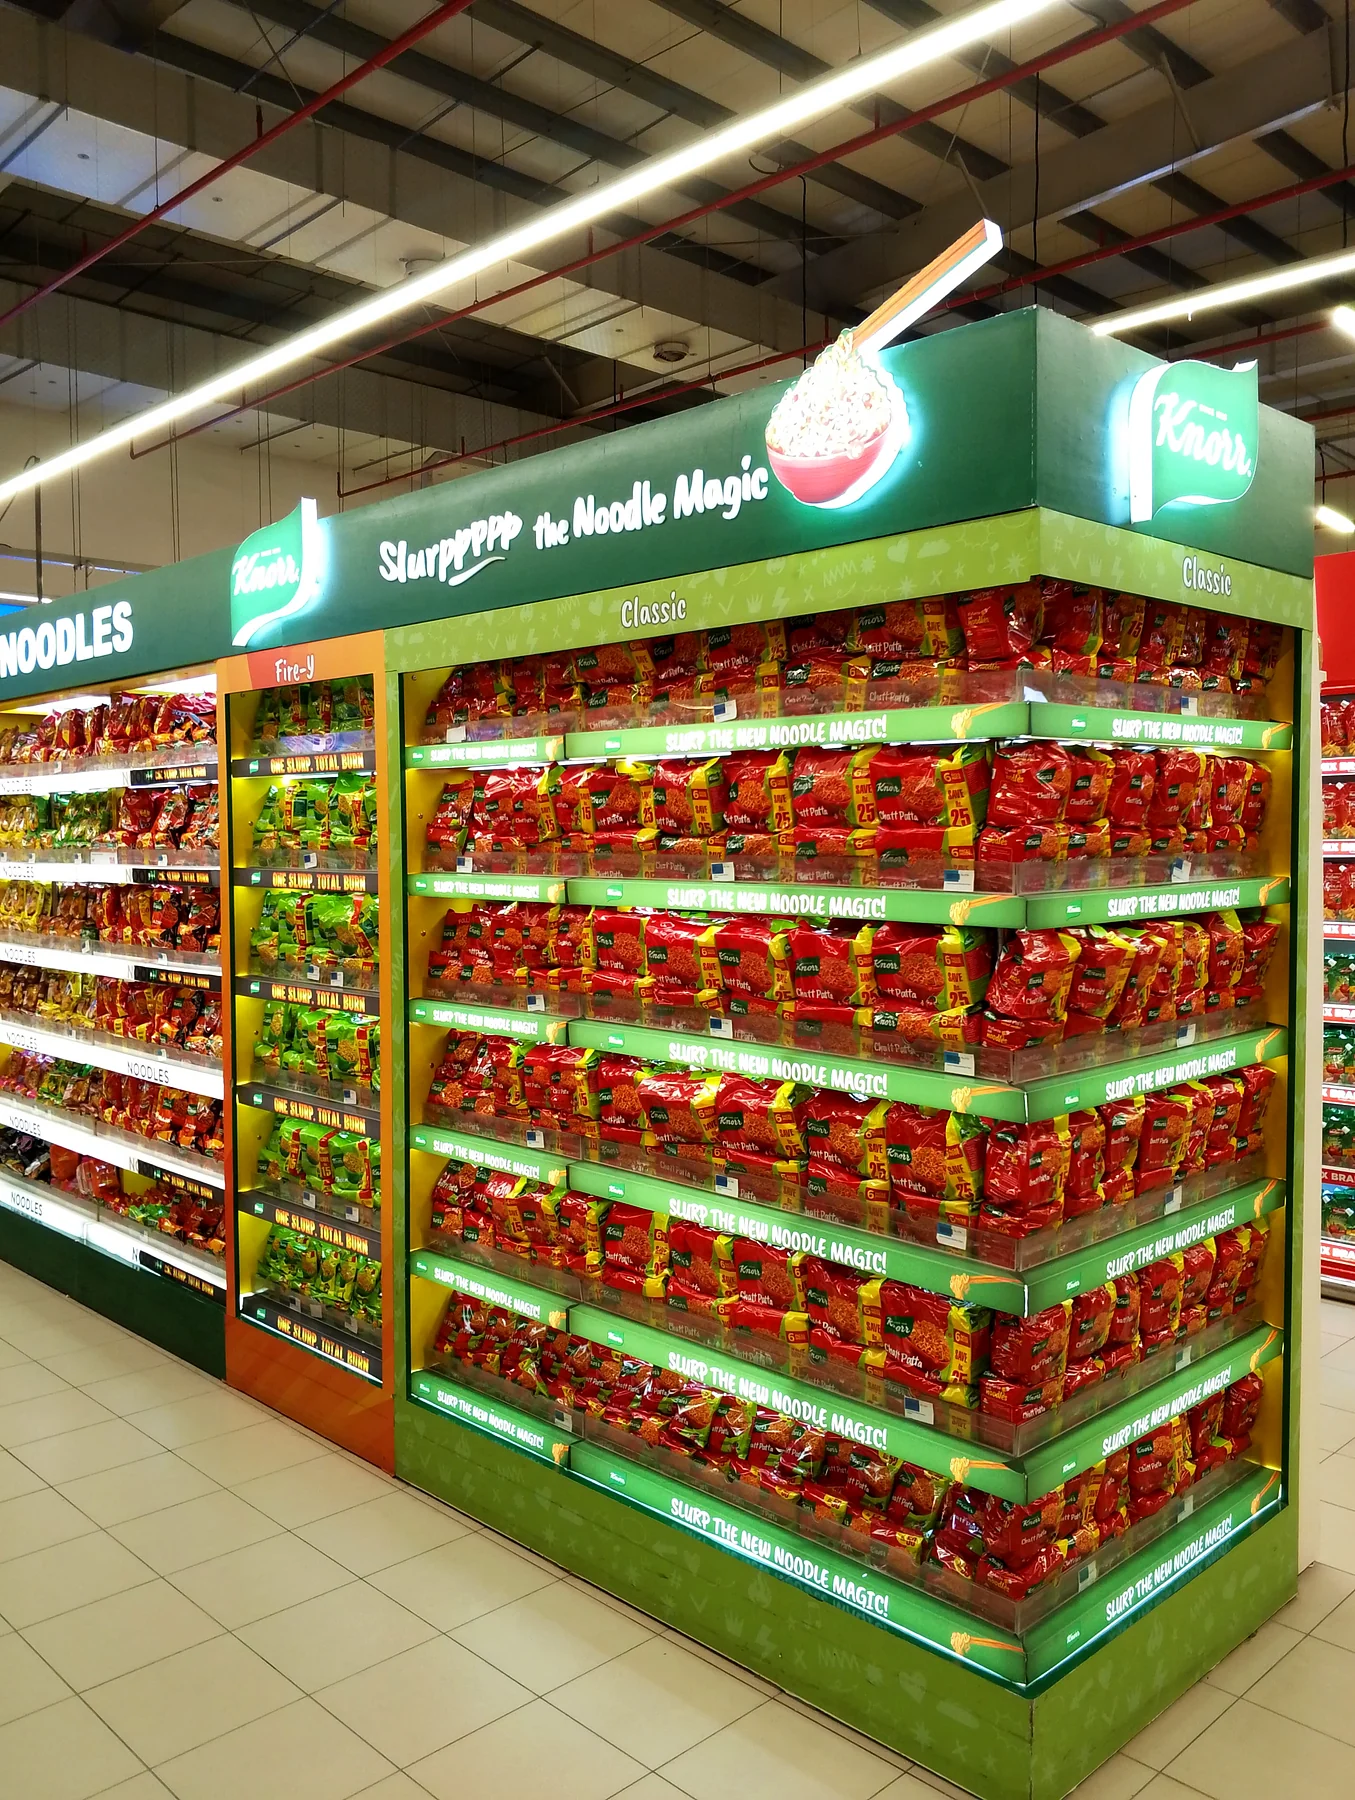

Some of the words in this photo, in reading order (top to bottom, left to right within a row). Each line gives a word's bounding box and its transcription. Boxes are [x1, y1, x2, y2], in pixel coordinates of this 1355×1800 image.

[1154, 392, 1252, 478] Knorr
[379, 511, 523, 583] Slurppppp
[533, 512, 569, 549] the
[573, 481, 667, 538] Noodle
[673, 454, 769, 520] Magic
[232, 553, 300, 596] Knorr
[1183, 555, 1232, 596] Classic
[621, 591, 687, 628] Classic
[858, 614, 886, 627] Knorr
[0, 601, 134, 679] NOODLES
[275, 654, 316, 682] Fire-y
[665, 730, 706, 753] SLURP
[708, 729, 734, 750] THE
[736, 727, 767, 749] NEW
[769, 723, 826, 746] NOODLE
[828, 714, 886, 743] MAGIC!
[1112, 719, 1142, 740] SLURP
[1142, 720, 1161, 739] THE
[1162, 722, 1181, 740] NEW
[1182, 724, 1214, 742] NOODLE
[269, 758, 286, 774] ONE
[286, 755, 314, 773] SLURP.
[314, 754, 339, 772] TOTAL
[341, 752, 364, 769] BURN
[855, 783, 872, 793] SAVE
[948, 789, 965, 800] SAVE
[857, 803, 875, 822] 25
[878, 810, 899, 821] Chatt
[900, 811, 918, 821] Patta
[950, 807, 971, 826] 25
[273, 872, 288, 888] ONE
[288, 873, 314, 889] SLURP.
[317, 874, 341, 890] TOTAL
[343, 873, 365, 892] BURN
[667, 888, 706, 908] SLURP
[708, 889, 734, 910] THE
[736, 891, 767, 911] NEW
[770, 893, 825, 915] NOODLE
[829, 896, 885, 918] MAGIC!
[1108, 897, 1139, 916] SLURP
[1139, 896, 1157, 912] THE
[1158, 894, 1177, 911] NEW
[1179, 891, 1210, 910] NOODLE
[1212, 887, 1239, 907] MAGIC!
[719, 951, 740, 963] Knorr
[796, 961, 819, 973] Knorr
[875, 958, 899, 970] Knorr
[272, 984, 286, 1000] ONE
[288, 987, 314, 1005] SLURP.
[316, 989, 340, 1009] TOTAL
[343, 993, 367, 1013] BURN
[796, 988, 815, 998] Chatt
[816, 989, 834, 999] Patta
[434, 1010, 454, 1022] SLURP
[454, 1012, 467, 1025] THE
[468, 1014, 483, 1026] NEW
[484, 1016, 511, 1031] NOODLE
[127, 1061, 170, 1084] NOODLES
[669, 1043, 708, 1067] SLURP
[710, 1048, 736, 1070] THE
[738, 1053, 768, 1074] NEW
[772, 1058, 827, 1085] NOODLE
[831, 1069, 887, 1095] MAGIC!
[1106, 1076, 1135, 1100] SLURP
[1136, 1072, 1154, 1091] THE
[1156, 1067, 1174, 1086] NEW
[1176, 1057, 1206, 1081] NOODLE
[1208, 1048, 1235, 1072] MAGIC!
[9, 1116, 41, 1137] NOODLES
[274, 1098, 288, 1114] ONE
[290, 1102, 317, 1121] SLURP.
[317, 1108, 341, 1128] TOTAL
[344, 1114, 367, 1135] BURN
[719, 1115, 742, 1126] Knorr
[434, 1140, 454, 1154] SLURP
[454, 1145, 468, 1159] THE
[469, 1149, 484, 1166] NEW
[485, 1153, 511, 1171] NOODLE
[722, 1140, 739, 1150] Chatt
[741, 1141, 760, 1151] Patta
[868, 1143, 883, 1153] SAVE
[887, 1148, 912, 1162] Knorr
[1331, 1172, 1355, 1183] BRA
[11, 1191, 43, 1216] NOODLES
[276, 1209, 289, 1226] ONE
[292, 1215, 317, 1237] SLURP.
[319, 1224, 343, 1246] TOTAL
[346, 1233, 368, 1255] BURN
[669, 1198, 708, 1225] SLURP
[709, 1209, 735, 1232] THE
[739, 1216, 769, 1240] NEW
[771, 1225, 826, 1255] NOODLE
[831, 1242, 886, 1274] MAGIC!
[1107, 1252, 1135, 1279] SLURP
[1136, 1244, 1153, 1264] THE
[1156, 1236, 1173, 1257] NEW
[1176, 1220, 1205, 1248] NOODLE
[1208, 1206, 1234, 1233] MAGIC!
[739, 1264, 761, 1276] Knorr
[435, 1268, 454, 1284] SLURP
[454, 1275, 469, 1290] THE
[469, 1281, 485, 1296] NEW
[486, 1287, 512, 1307] NOODLE
[740, 1291, 758, 1301] Chatt
[758, 1294, 774, 1305] Patta
[277, 1317, 292, 1334] ONE
[294, 1324, 318, 1346] SLURP.
[320, 1338, 344, 1359] TOTAL
[347, 1351, 368, 1373] BURN
[900, 1353, 923, 1368] Patta
[438, 1391, 458, 1408] SLURP
[459, 1400, 472, 1415] THE
[473, 1406, 488, 1422] NEW
[489, 1414, 515, 1436] NOODLE
[669, 1352, 708, 1380] SLURP
[710, 1367, 737, 1394] THE
[738, 1378, 769, 1404] NEW
[772, 1390, 827, 1427] NOODLE
[832, 1414, 886, 1450] MAGIC!
[1102, 1425, 1131, 1455] SLURP
[1132, 1414, 1150, 1436] THE
[1151, 1404, 1170, 1426] NEW
[1171, 1384, 1202, 1415] NOODLE
[1203, 1366, 1231, 1396] MAGIC!
[671, 1498, 710, 1530] SLURP
[713, 1518, 738, 1542] THE
[741, 1531, 771, 1559] NEW
[774, 1546, 829, 1588] NOODLE
[833, 1576, 888, 1617] MAGIC!
[1107, 1587, 1134, 1620] SLURP
[1135, 1573, 1153, 1592] THE
[1154, 1560, 1173, 1584] NEW
[1174, 1536, 1203, 1570] NOODLE
[1205, 1514, 1232, 1544] MAGIC!
